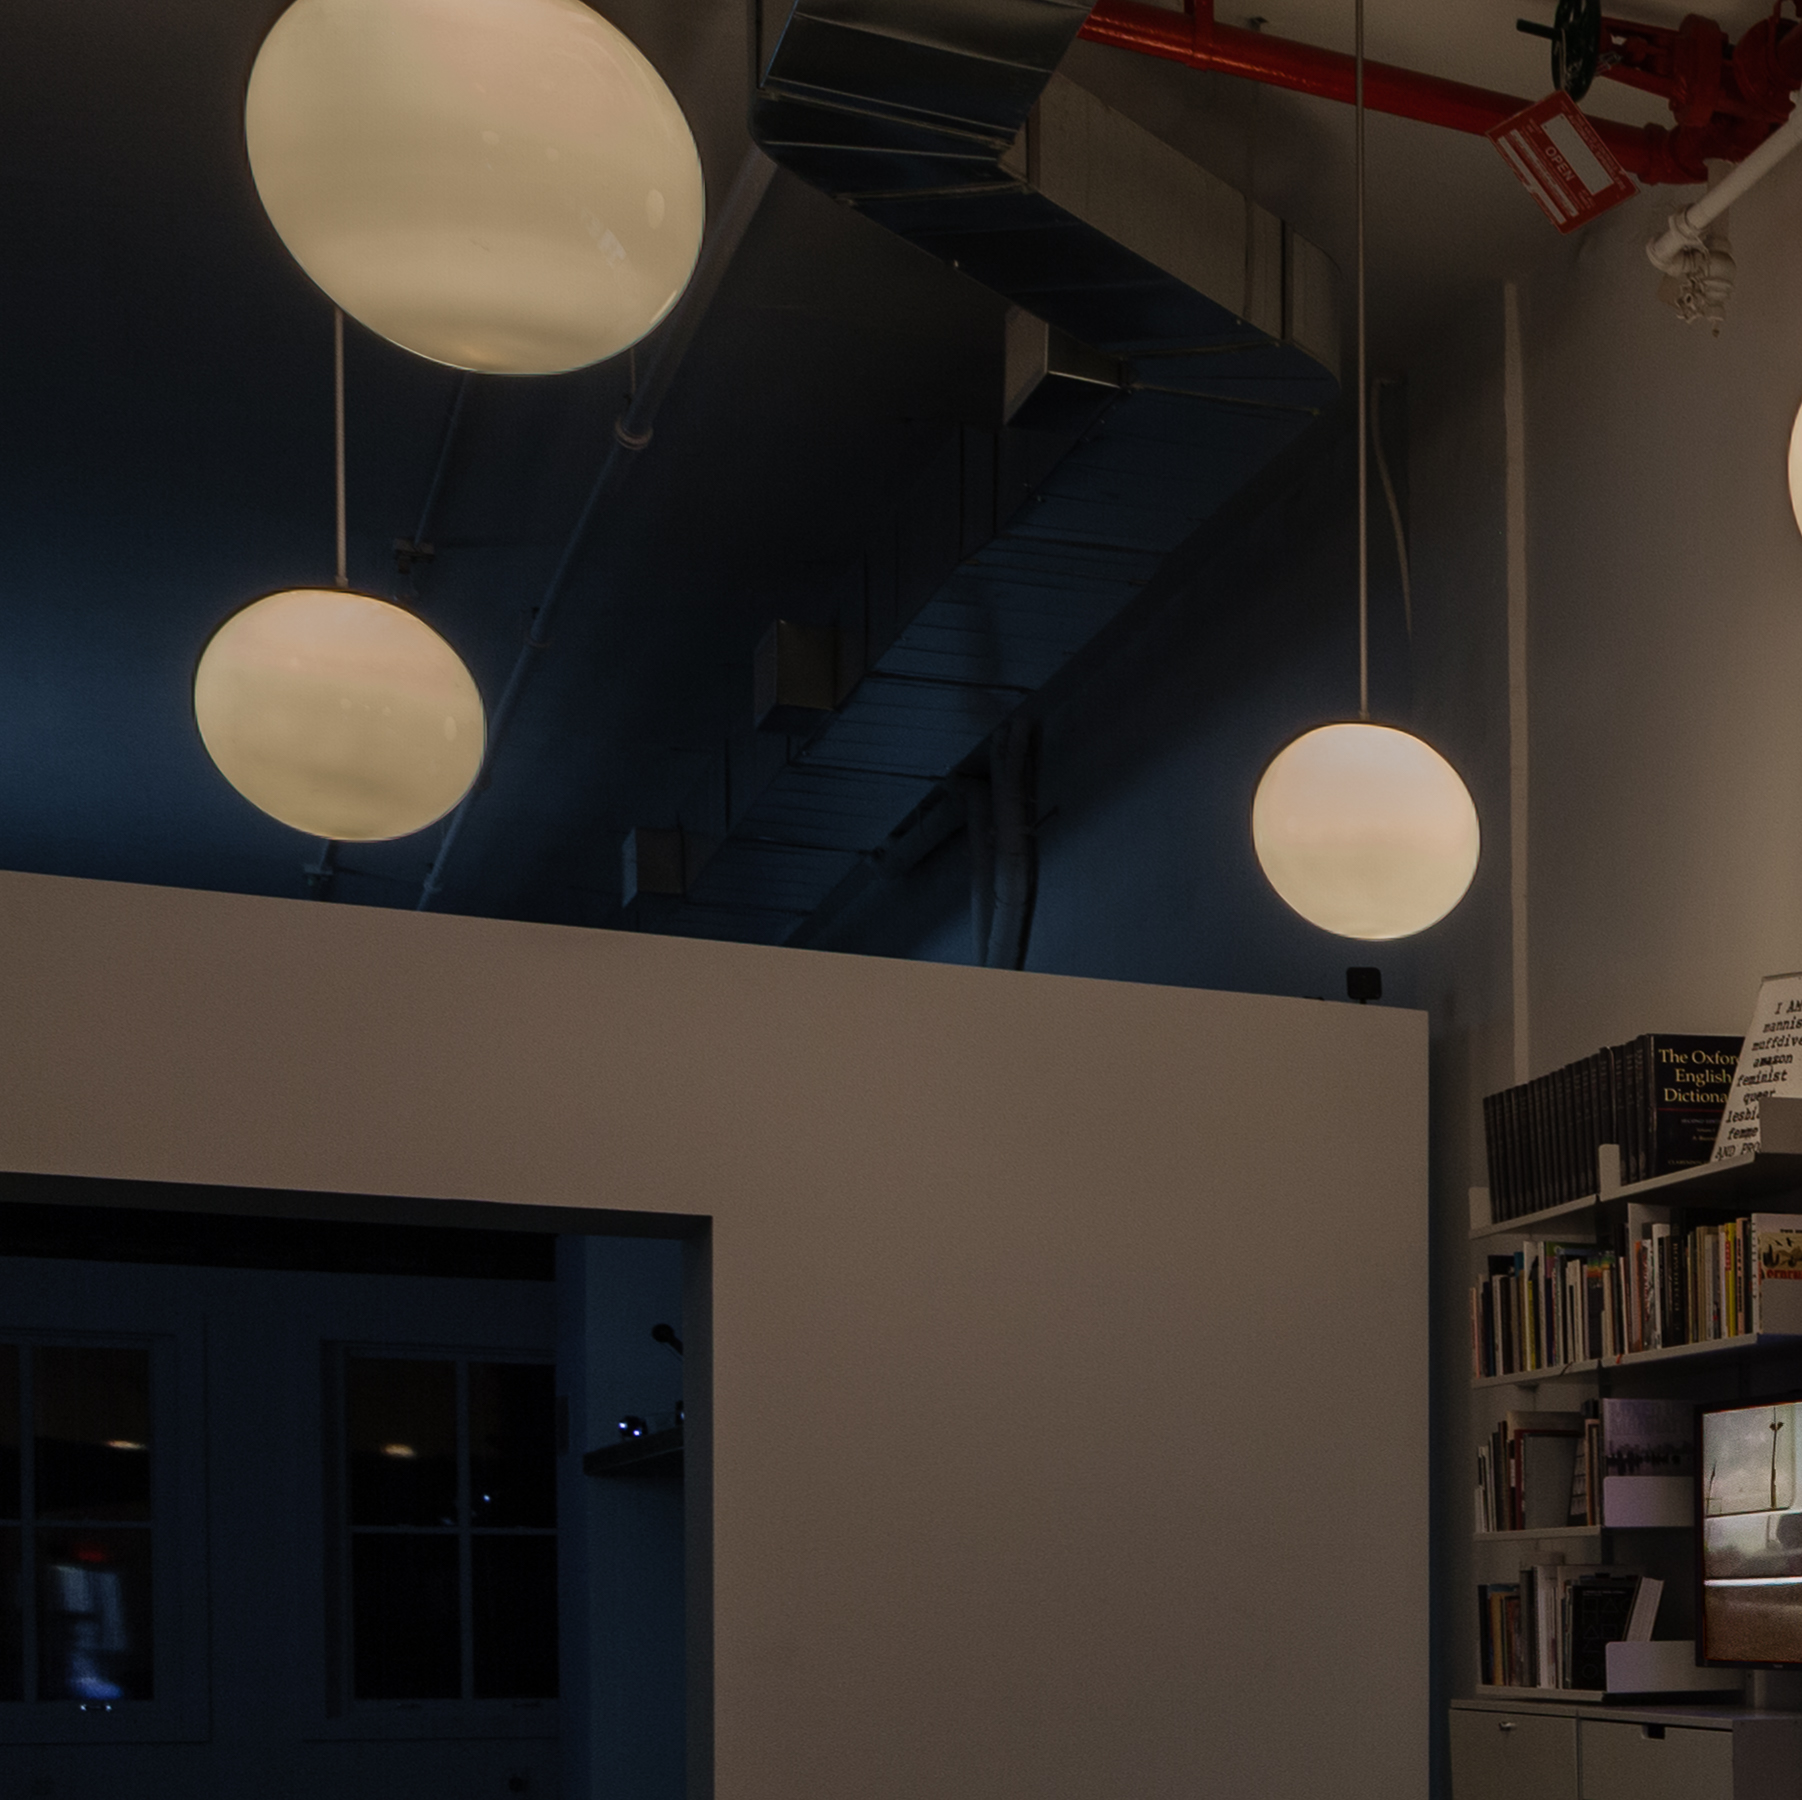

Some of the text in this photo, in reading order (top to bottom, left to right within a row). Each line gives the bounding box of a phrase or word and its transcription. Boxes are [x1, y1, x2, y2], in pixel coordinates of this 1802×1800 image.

[1775, 1002, 1783, 1015] I
[1658, 1048, 1690, 1065] The
[1674, 1067, 1732, 1087] English
[1737, 1069, 1788, 1087] feminist
